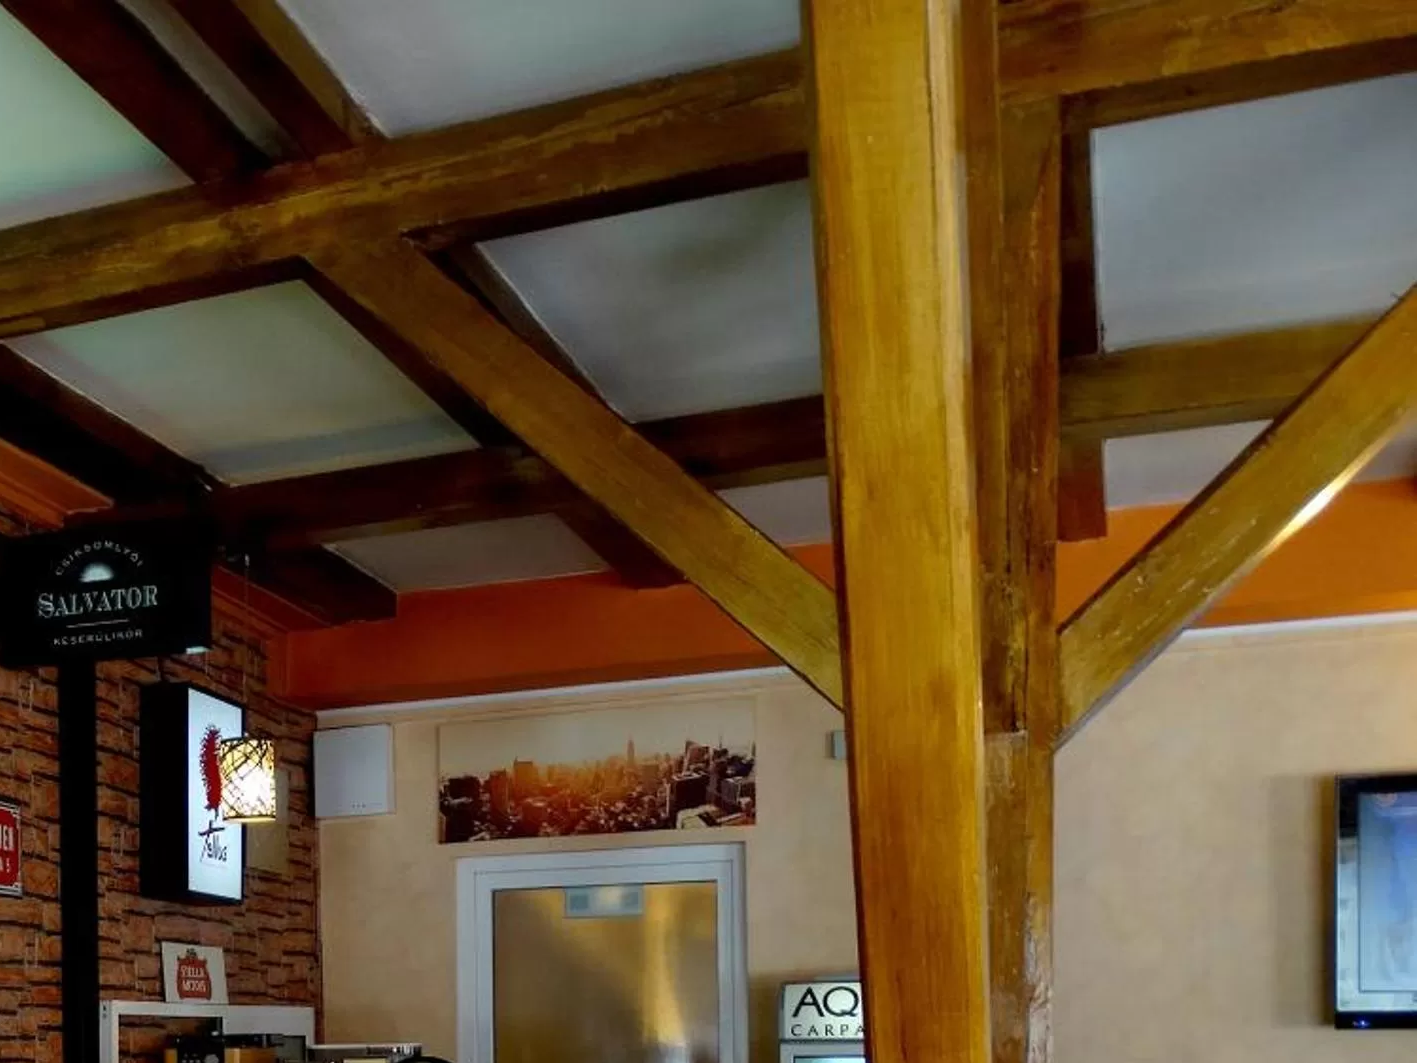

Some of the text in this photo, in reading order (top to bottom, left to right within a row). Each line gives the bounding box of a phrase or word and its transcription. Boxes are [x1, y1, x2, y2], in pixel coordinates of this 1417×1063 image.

[38, 584, 158, 618] SALVATOR
[791, 985, 859, 1018] AQ
[790, 1023, 866, 1037] CARPA
